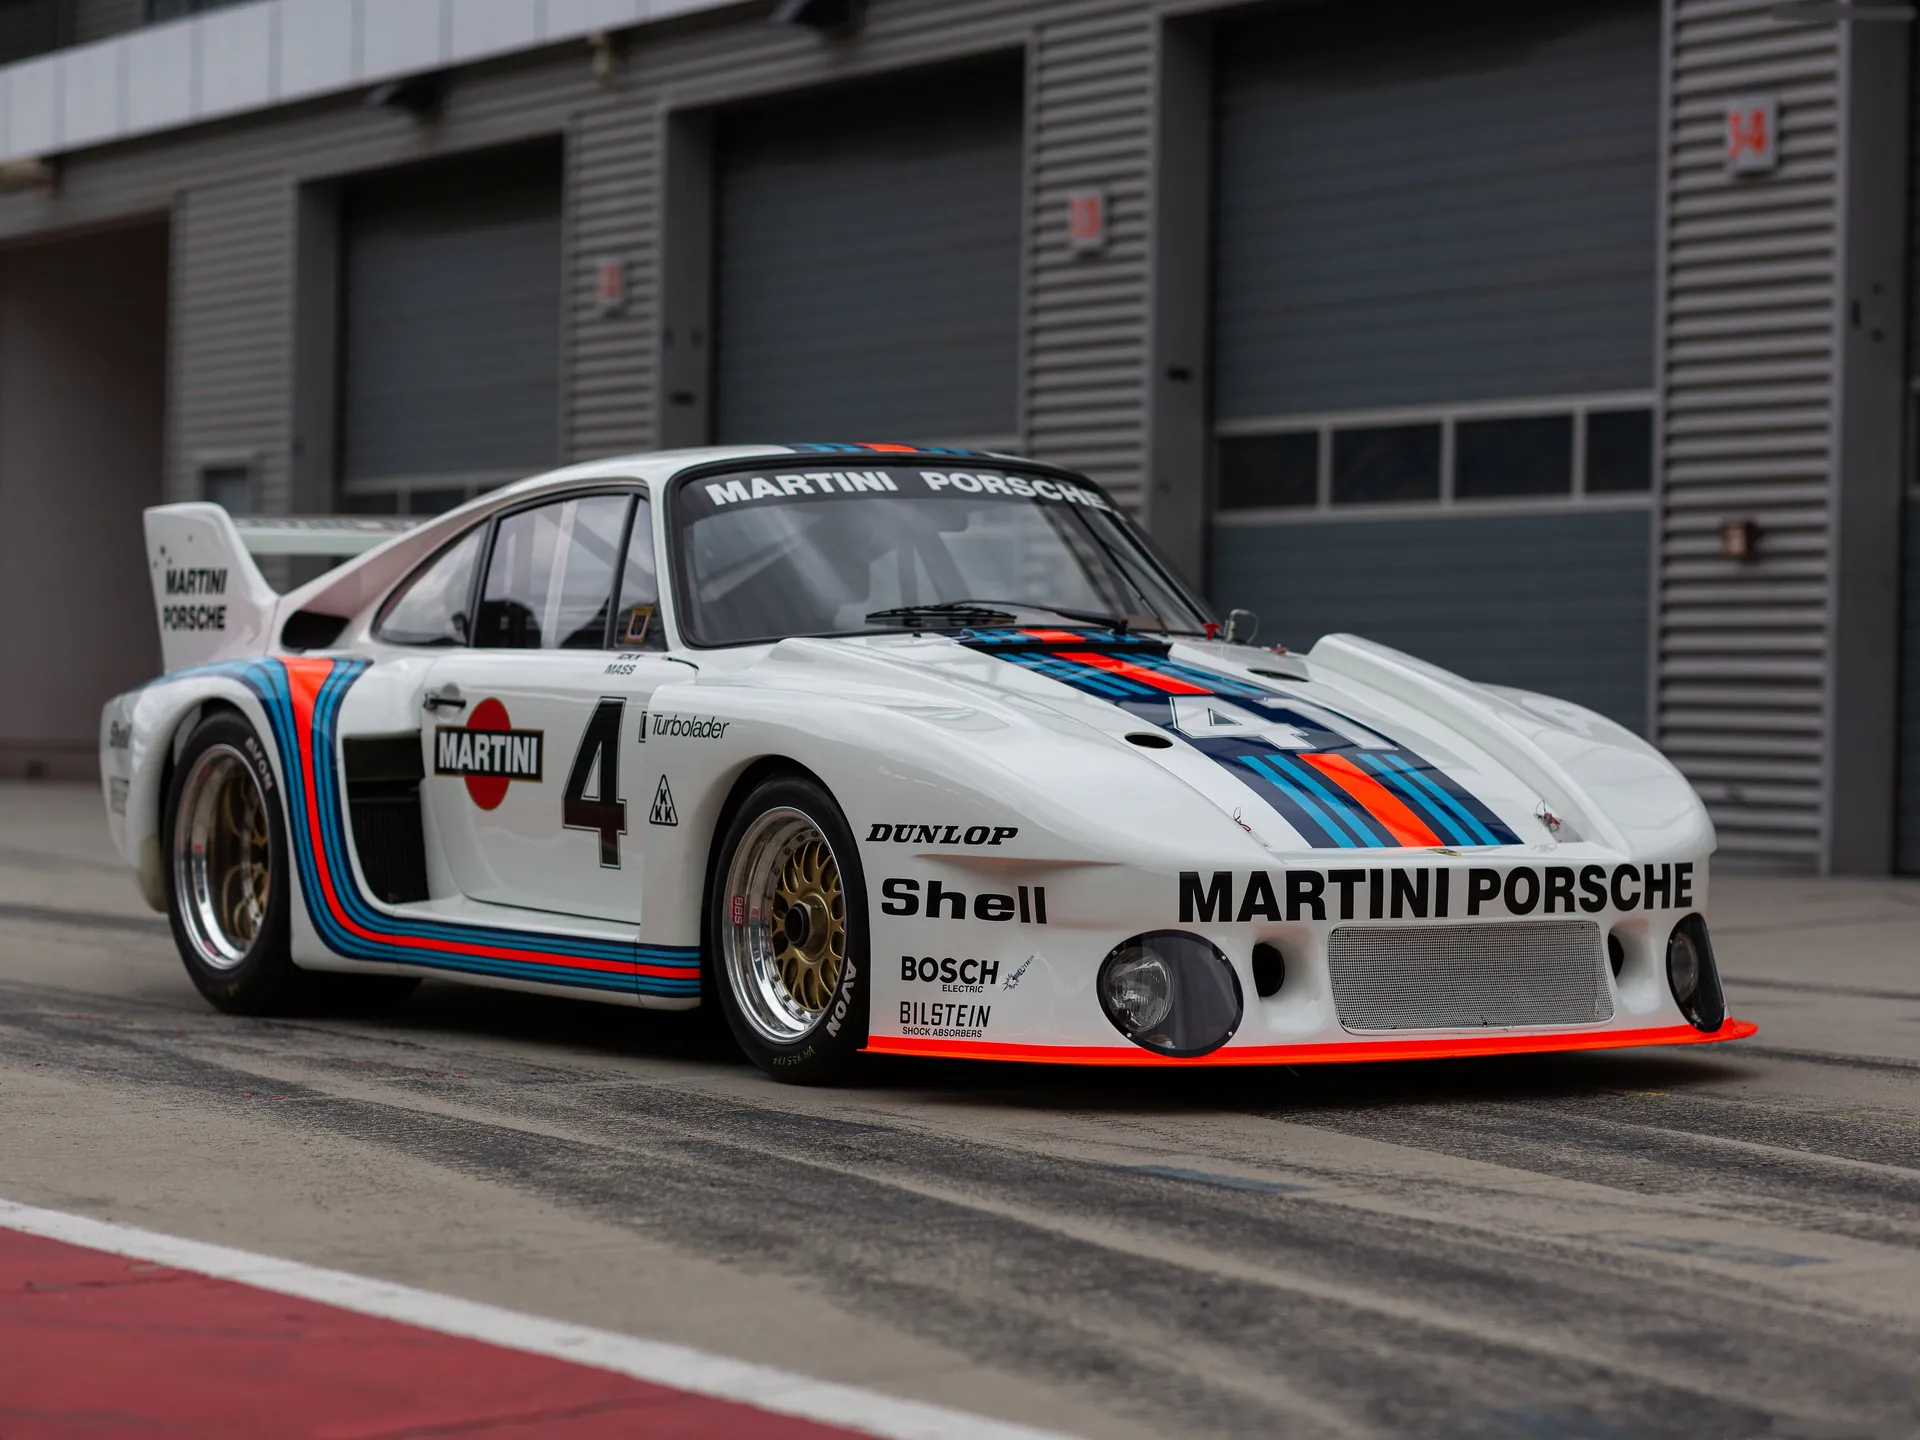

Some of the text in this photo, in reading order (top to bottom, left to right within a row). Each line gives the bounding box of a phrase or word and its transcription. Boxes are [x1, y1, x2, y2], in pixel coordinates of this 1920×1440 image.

[705, 471, 1111, 511] MARTINI PORSCHE
[166, 568, 228, 595] MARTINI
[163, 605, 226, 632] PORSCHE
[603, 663, 637, 675] MASS
[652, 714, 730, 740] Turbolader
[244, 736, 274, 792] AVON
[438, 731, 539, 776] MARTINI
[865, 823, 1019, 846] DUNLOP
[881, 877, 1048, 925] Shell
[1178, 862, 1694, 923] MARTINI PORSCHE
[734, 896, 744, 925] BBS
[901, 955, 1000, 985] BOSCH
[825, 956, 857, 1038] AVON
[942, 984, 984, 994] ELECTRIC
[900, 1000, 991, 1028] BILSTEIN
[902, 1026, 983, 1038] SHOCK ABSORBERS
